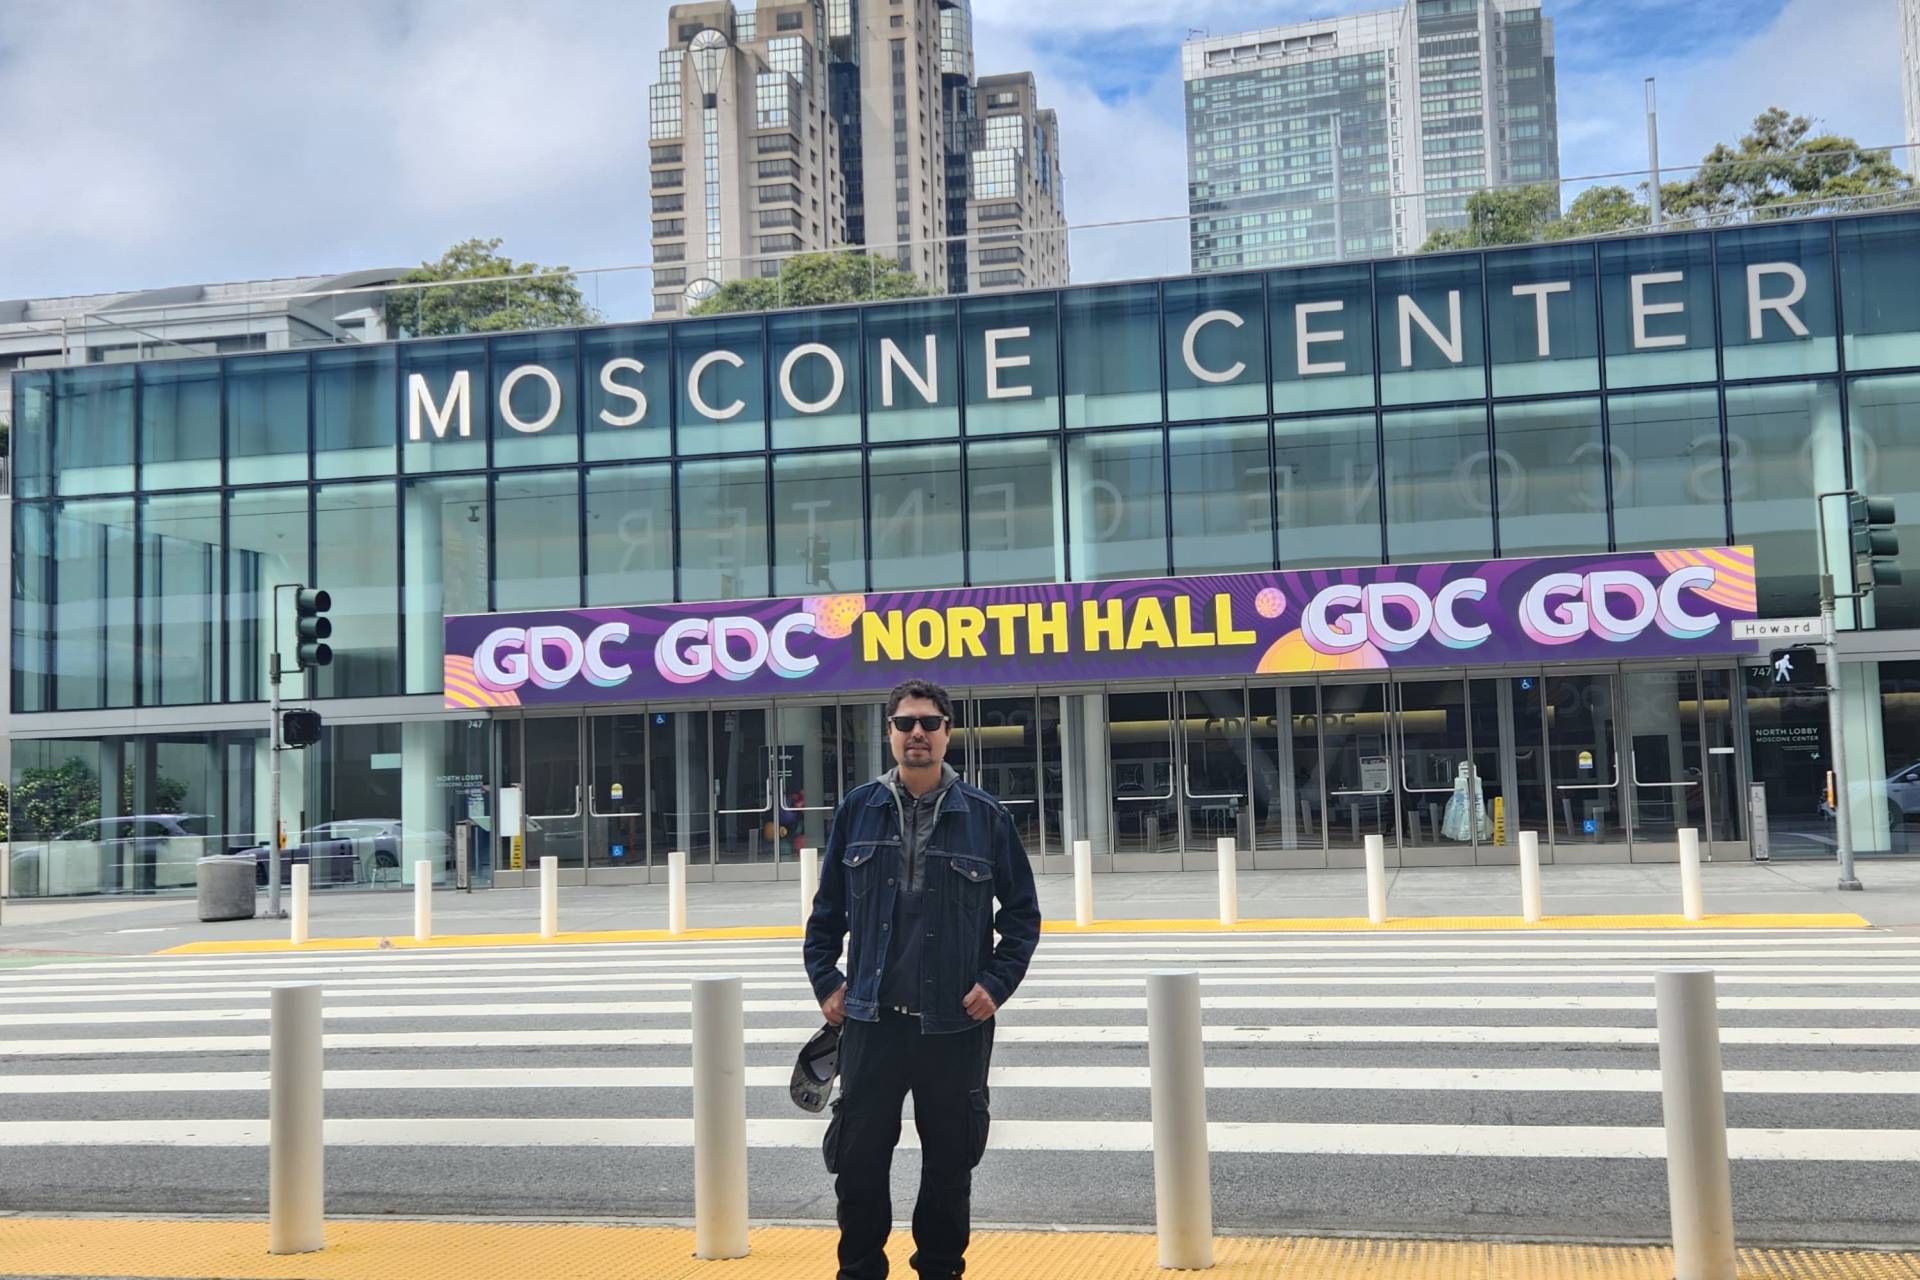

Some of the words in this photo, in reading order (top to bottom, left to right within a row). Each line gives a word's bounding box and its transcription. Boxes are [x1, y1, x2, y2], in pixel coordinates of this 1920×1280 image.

[408, 326, 1033, 441] MOSCONE
[1182, 261, 1811, 383] CENTER
[473, 621, 633, 693] GDC
[654, 611, 820, 685] GDC
[861, 601, 1069, 662] NORTH
[1082, 593, 1257, 652] HALL
[1301, 576, 1493, 656] GDC
[1518, 565, 1721, 646] GDC
[1745, 621, 1811, 635] Howard
[1751, 666, 1772, 677] 747
[467, 720, 483, 729] 747
[1755, 728, 1787, 737] NORTH
[1789, 727, 1819, 736] LOBBY
